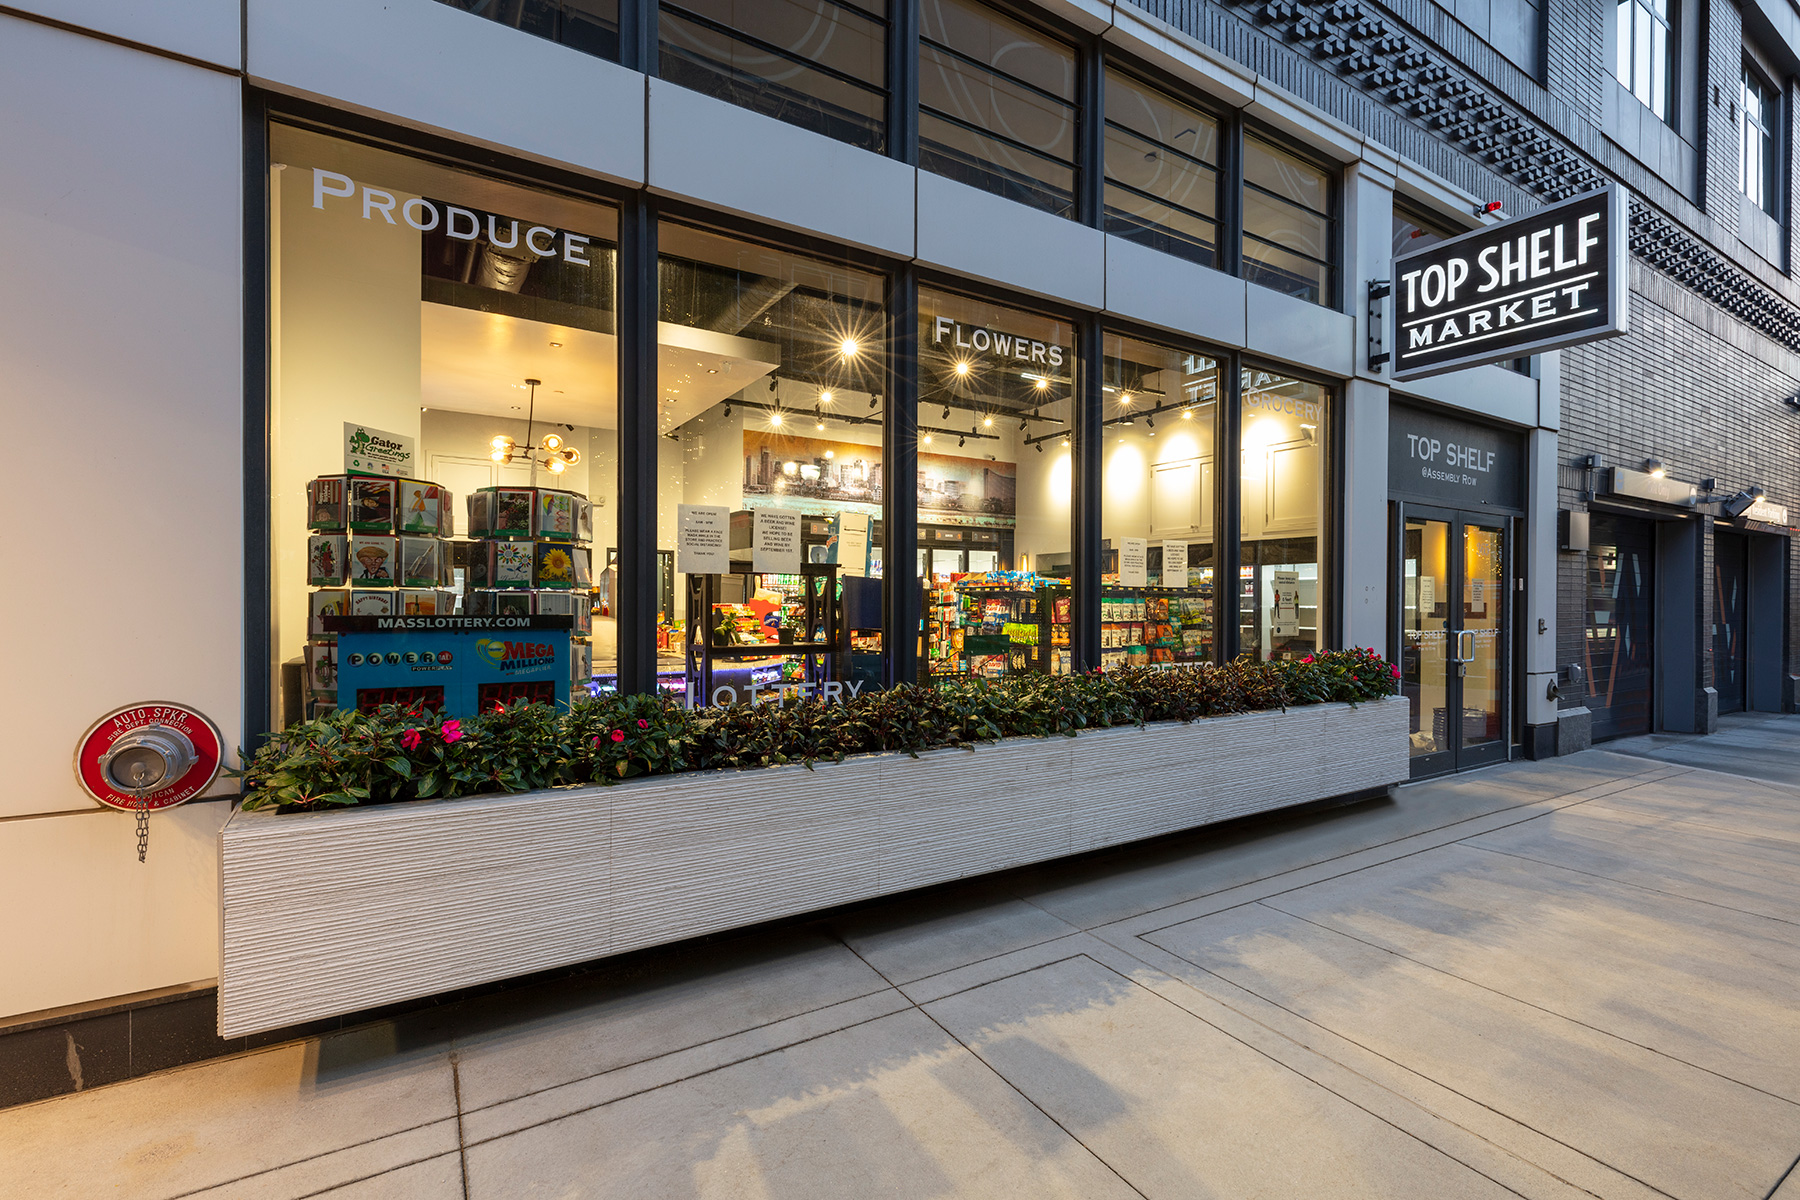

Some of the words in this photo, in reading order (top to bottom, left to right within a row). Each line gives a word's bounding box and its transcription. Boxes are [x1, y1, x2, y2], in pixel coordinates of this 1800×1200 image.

[312, 167, 590, 267] PRODUCE
[1402, 258, 1469, 313] TOP
[1477, 212, 1600, 293] SHELF
[1409, 282, 1589, 349] MARKET
[936, 316, 1063, 366] FLOWERS
[1247, 386, 1323, 422] GROCERY
[365, 442, 411, 462] Greetings
[371, 436, 403, 450] Gator
[1407, 433, 1440, 461] TOP
[1446, 443, 1495, 472] SHELF
[378, 618, 530, 628] MASSLOTTERY.COM
[502, 641, 554, 660] MEGA
[500, 658, 554, 671] MILLIONS
[108, 727, 123, 742] FIRE
[149, 718, 194, 735] CONNECTION
[106, 793, 124, 805] FIRE
[164, 786, 196, 805] CABINET
